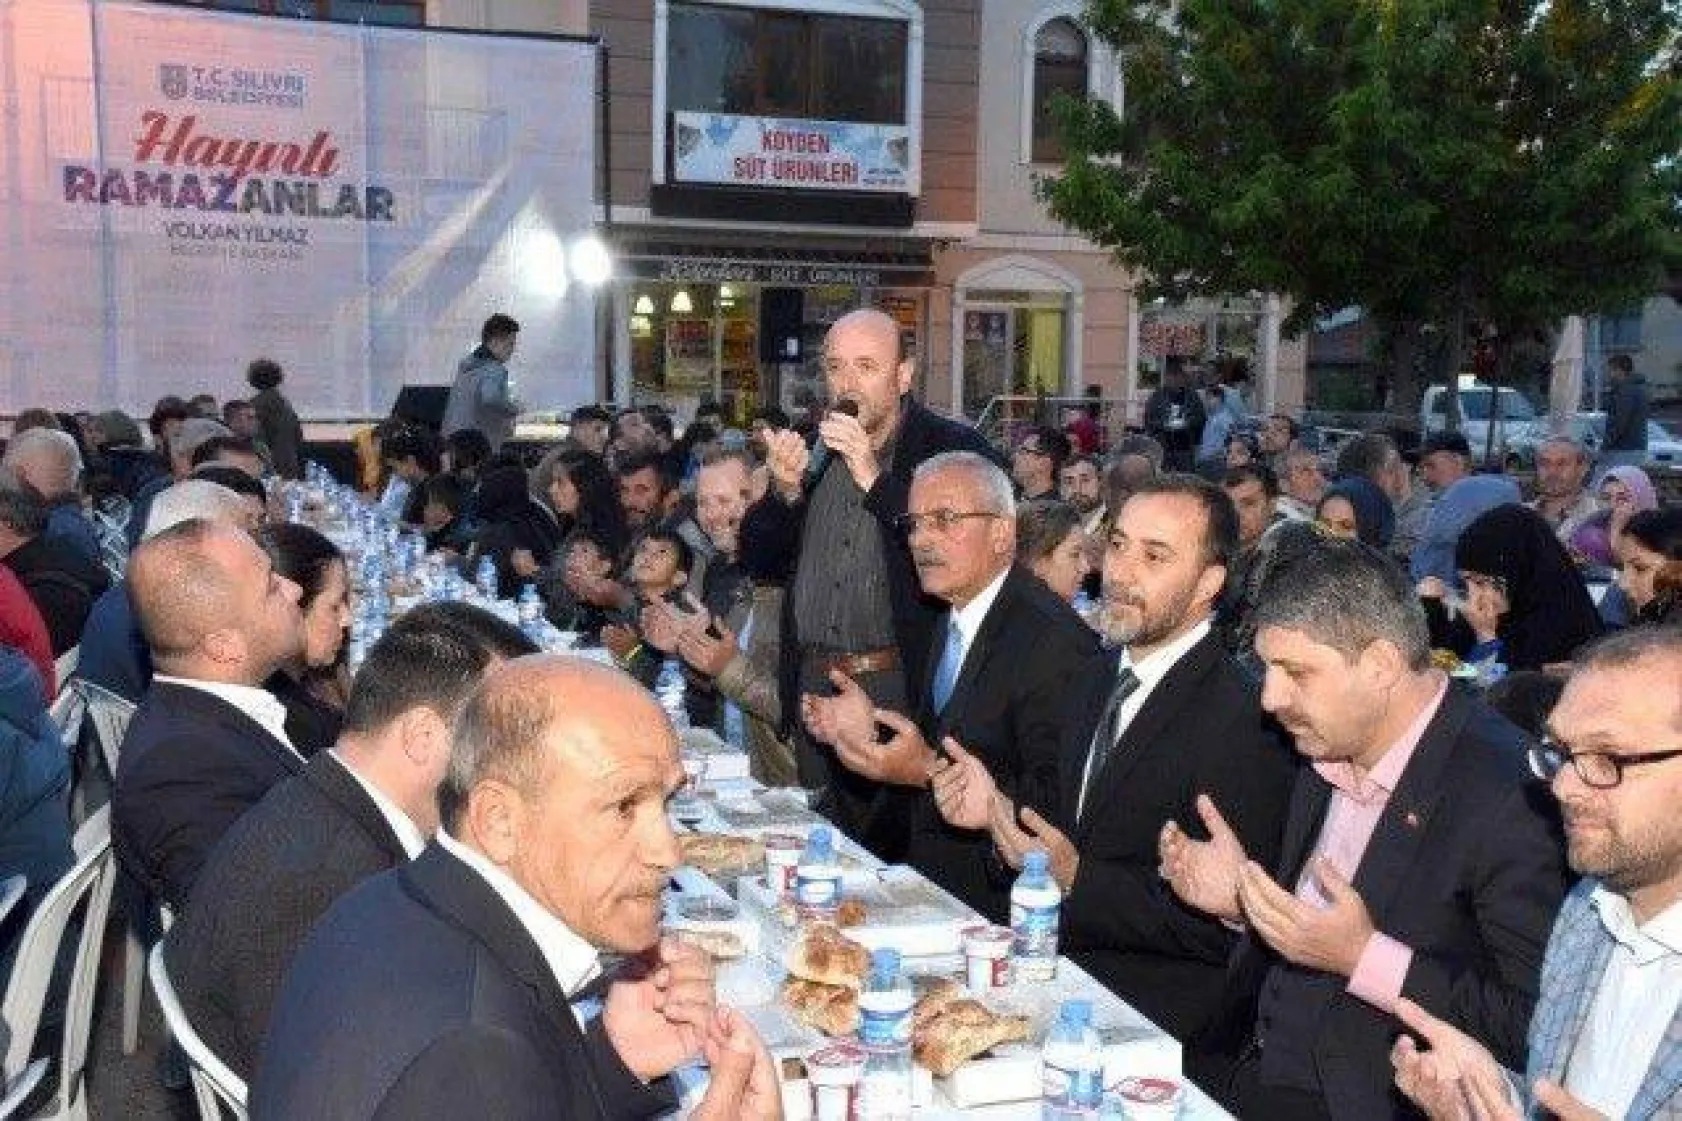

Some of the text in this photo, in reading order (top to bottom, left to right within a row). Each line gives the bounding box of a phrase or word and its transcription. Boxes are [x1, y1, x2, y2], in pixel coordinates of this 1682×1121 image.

[63, 165, 395, 221] RAMAZANLAR
[163, 220, 309, 245] VOLKAN YILMAZ
